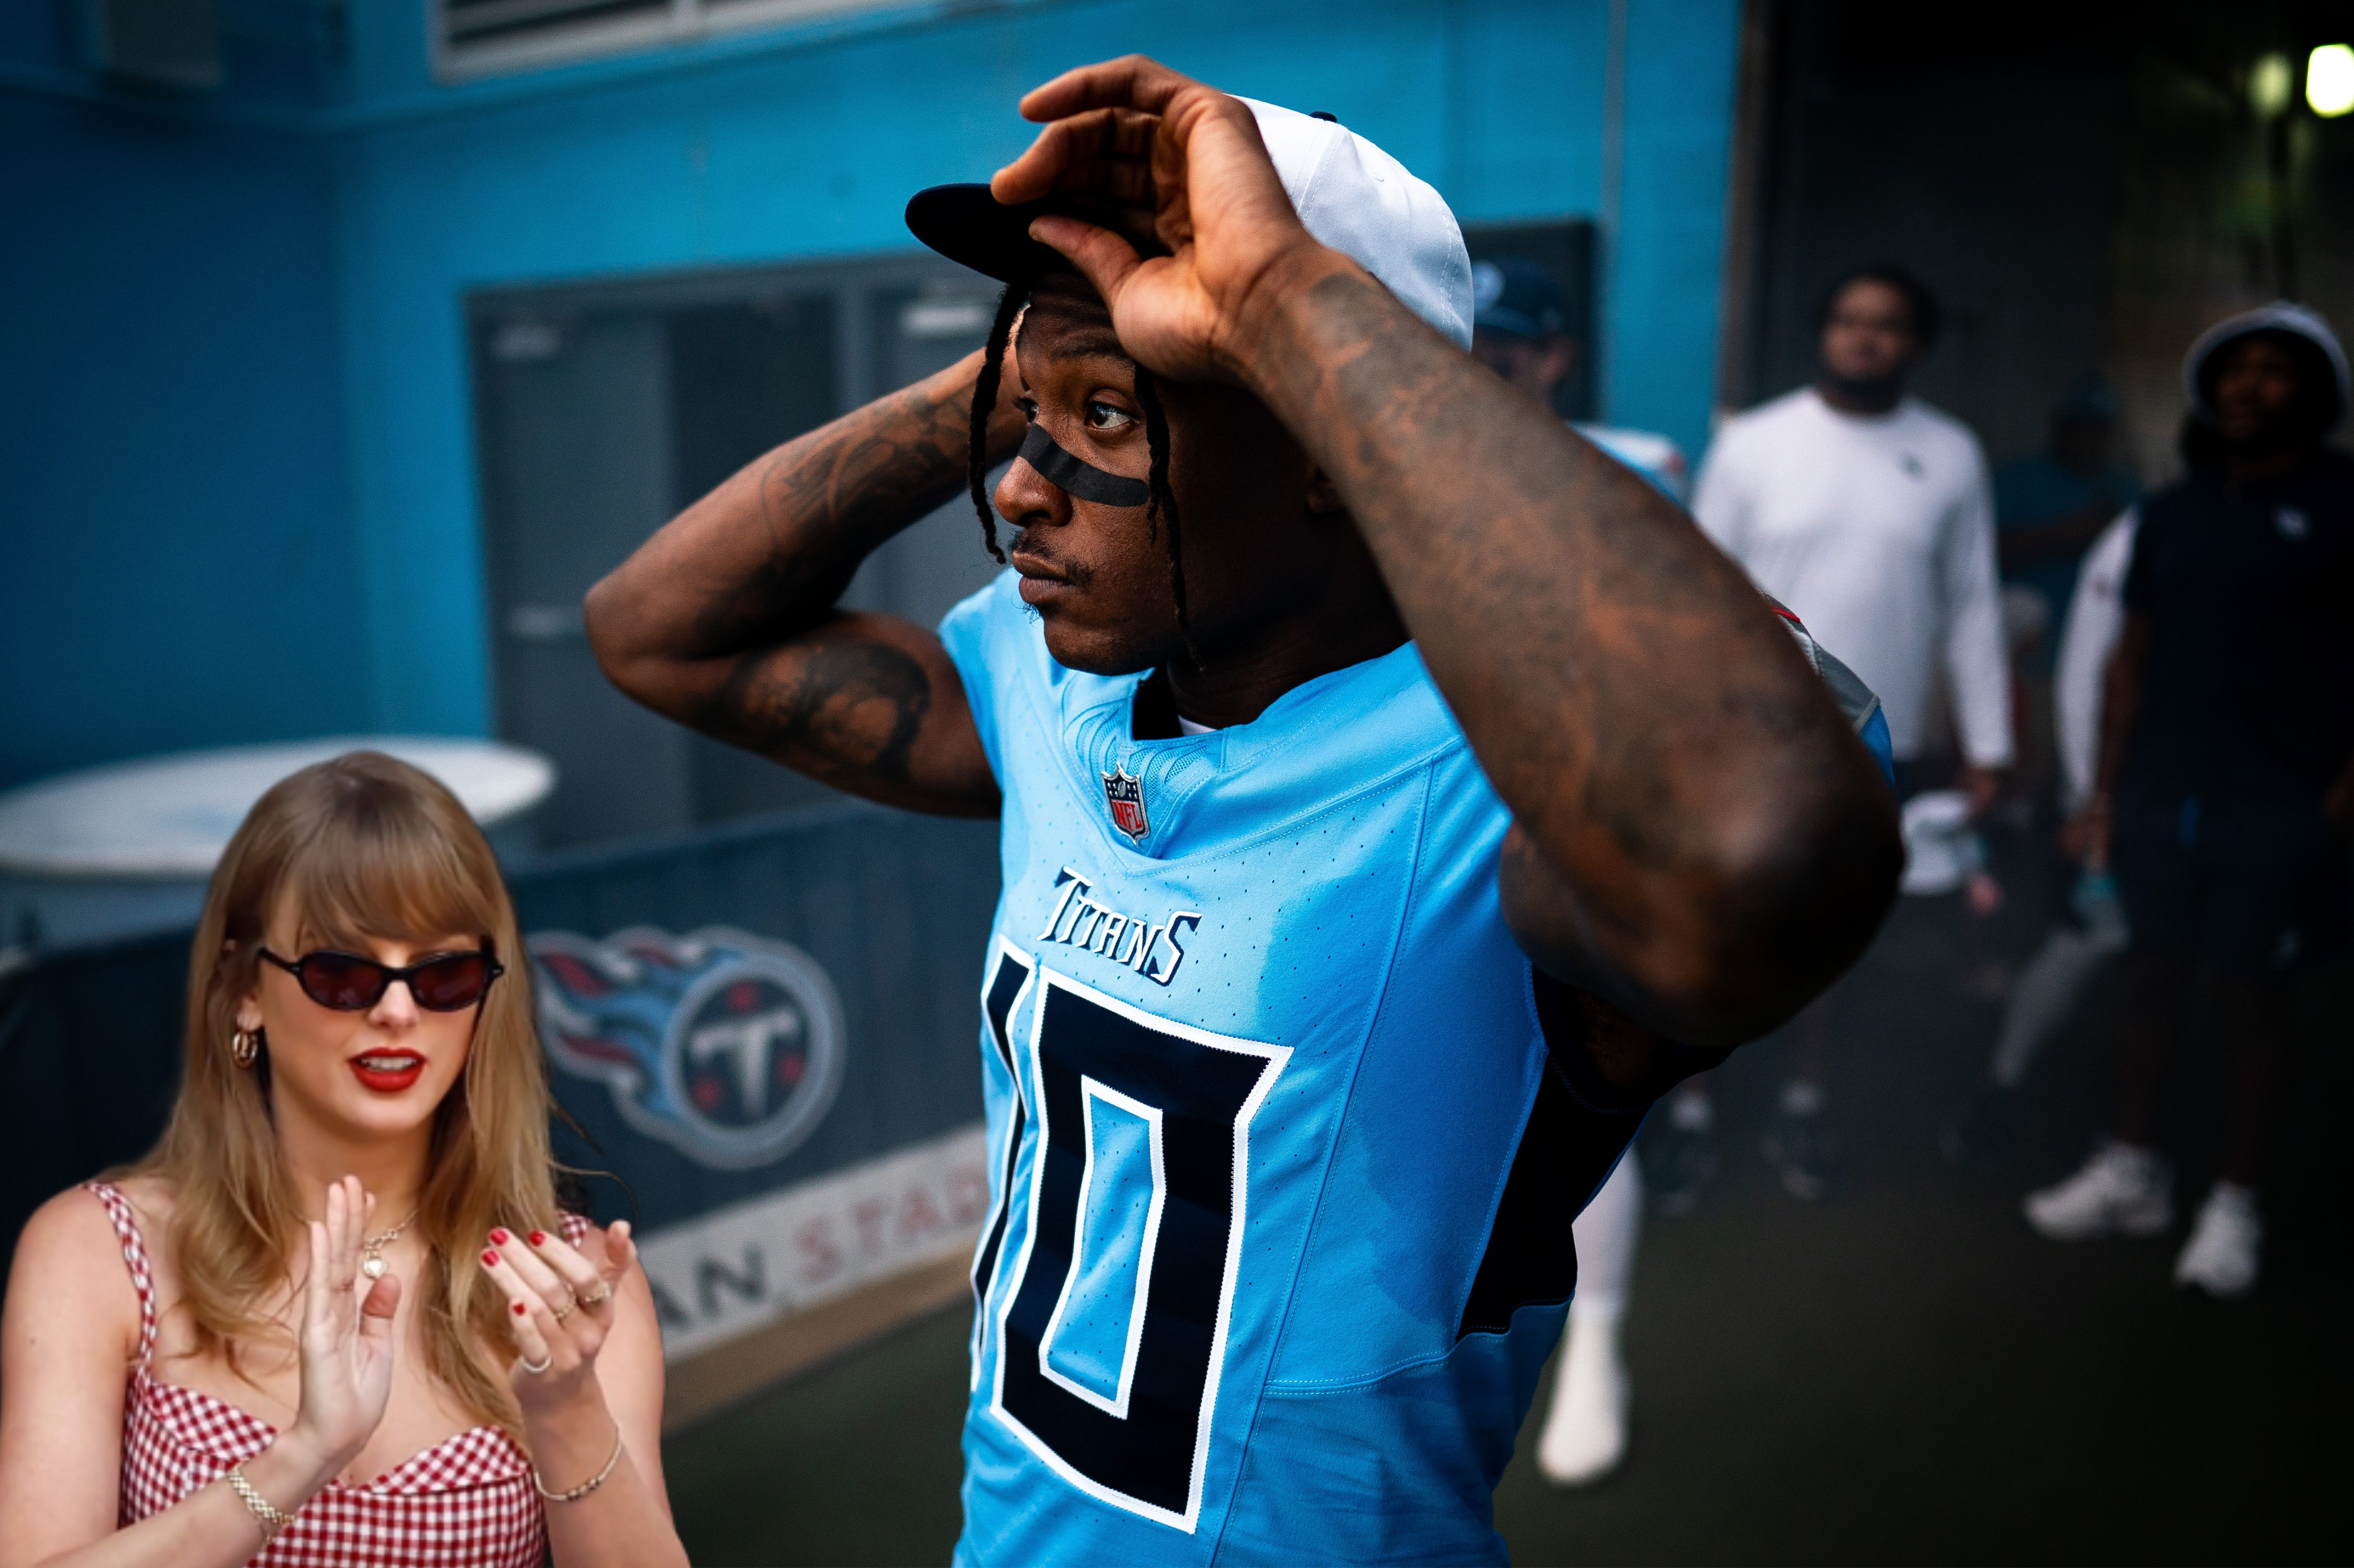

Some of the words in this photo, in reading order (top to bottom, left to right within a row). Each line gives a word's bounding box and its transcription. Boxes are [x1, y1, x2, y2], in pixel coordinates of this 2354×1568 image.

[1111, 800, 1143, 832] NFL
[1036, 866, 1202, 987] TITANS
[972, 934, 1295, 1535] 10
